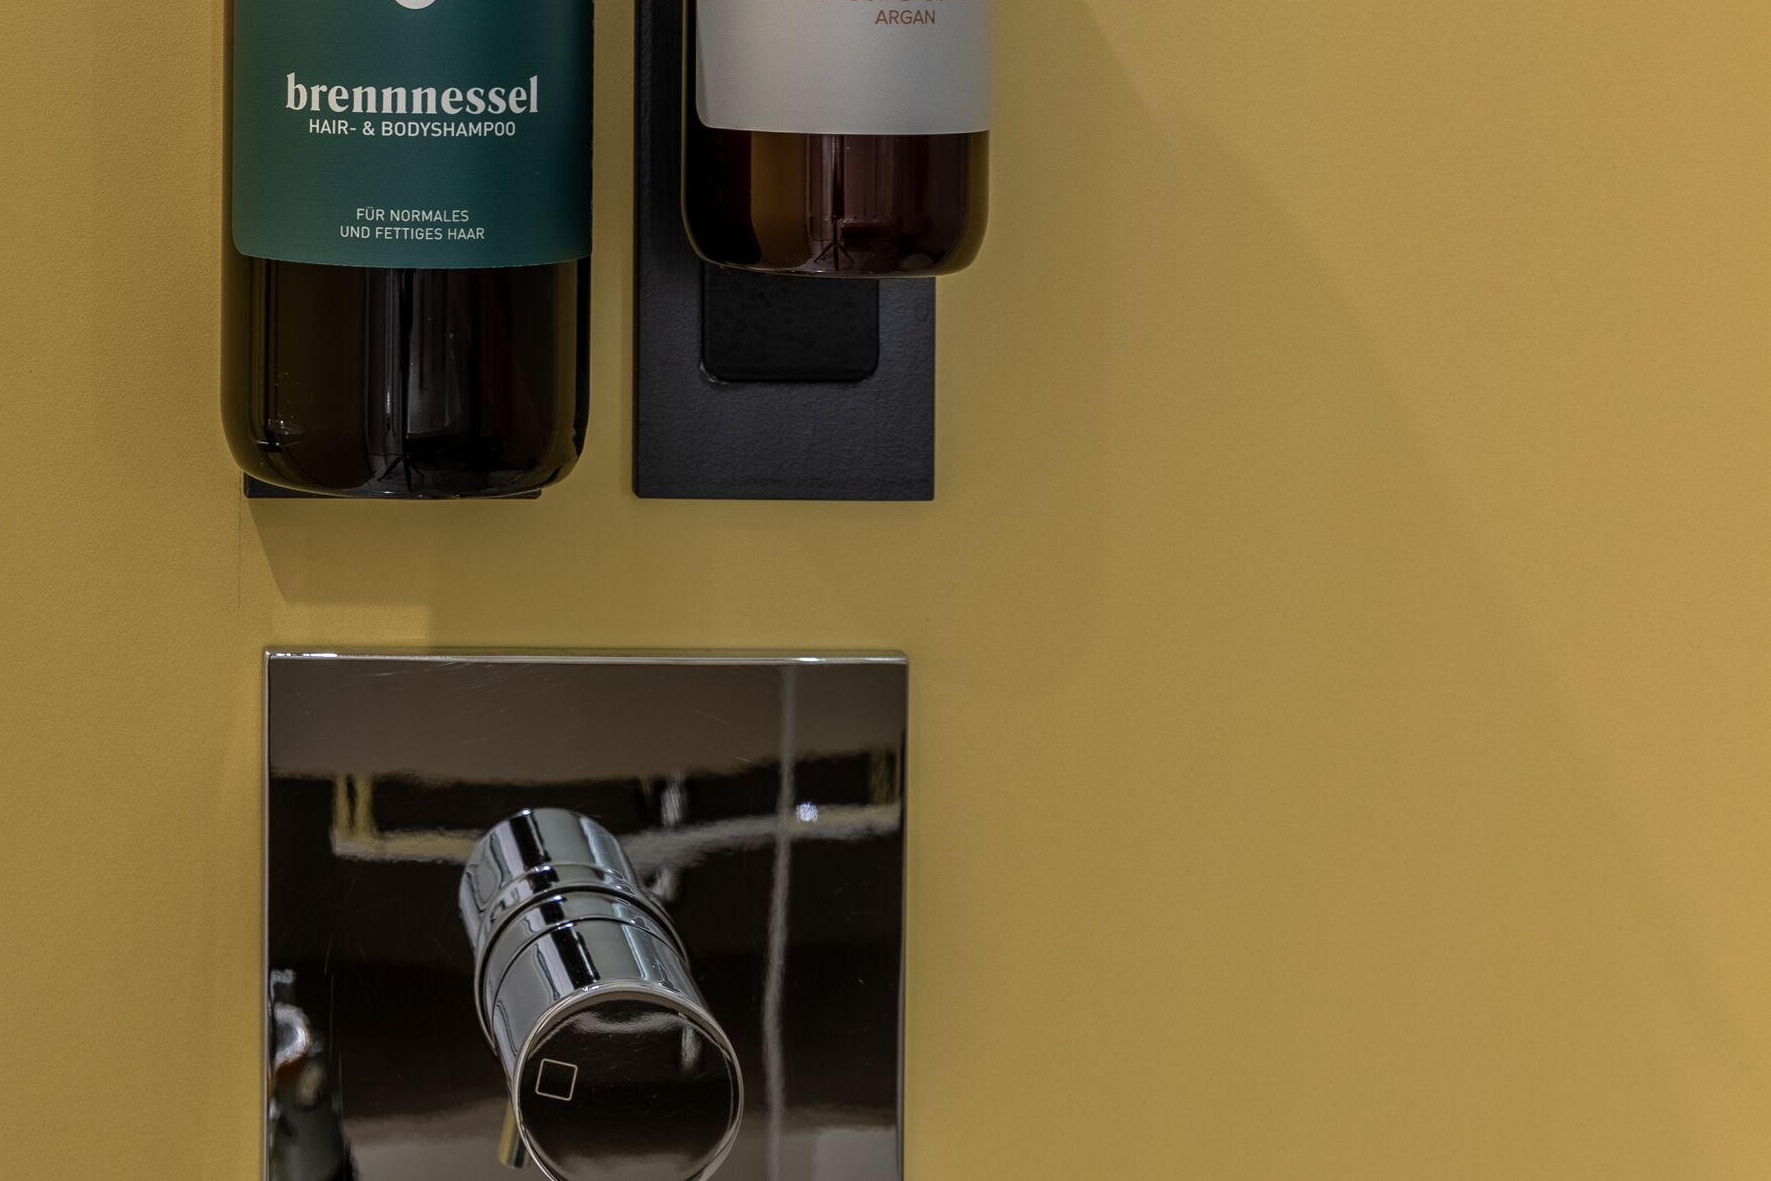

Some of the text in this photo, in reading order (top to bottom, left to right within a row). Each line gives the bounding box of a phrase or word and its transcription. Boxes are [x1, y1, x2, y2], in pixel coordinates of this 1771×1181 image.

[874, 10, 936, 25] ARGAN
[285, 72, 539, 115] brennnessel
[308, 119, 516, 137] HAIR- & BODYSHAMPOO
[356, 206, 470, 223] FÜR NORMALES
[339, 226, 485, 240] UND FETTIGES HAAR
